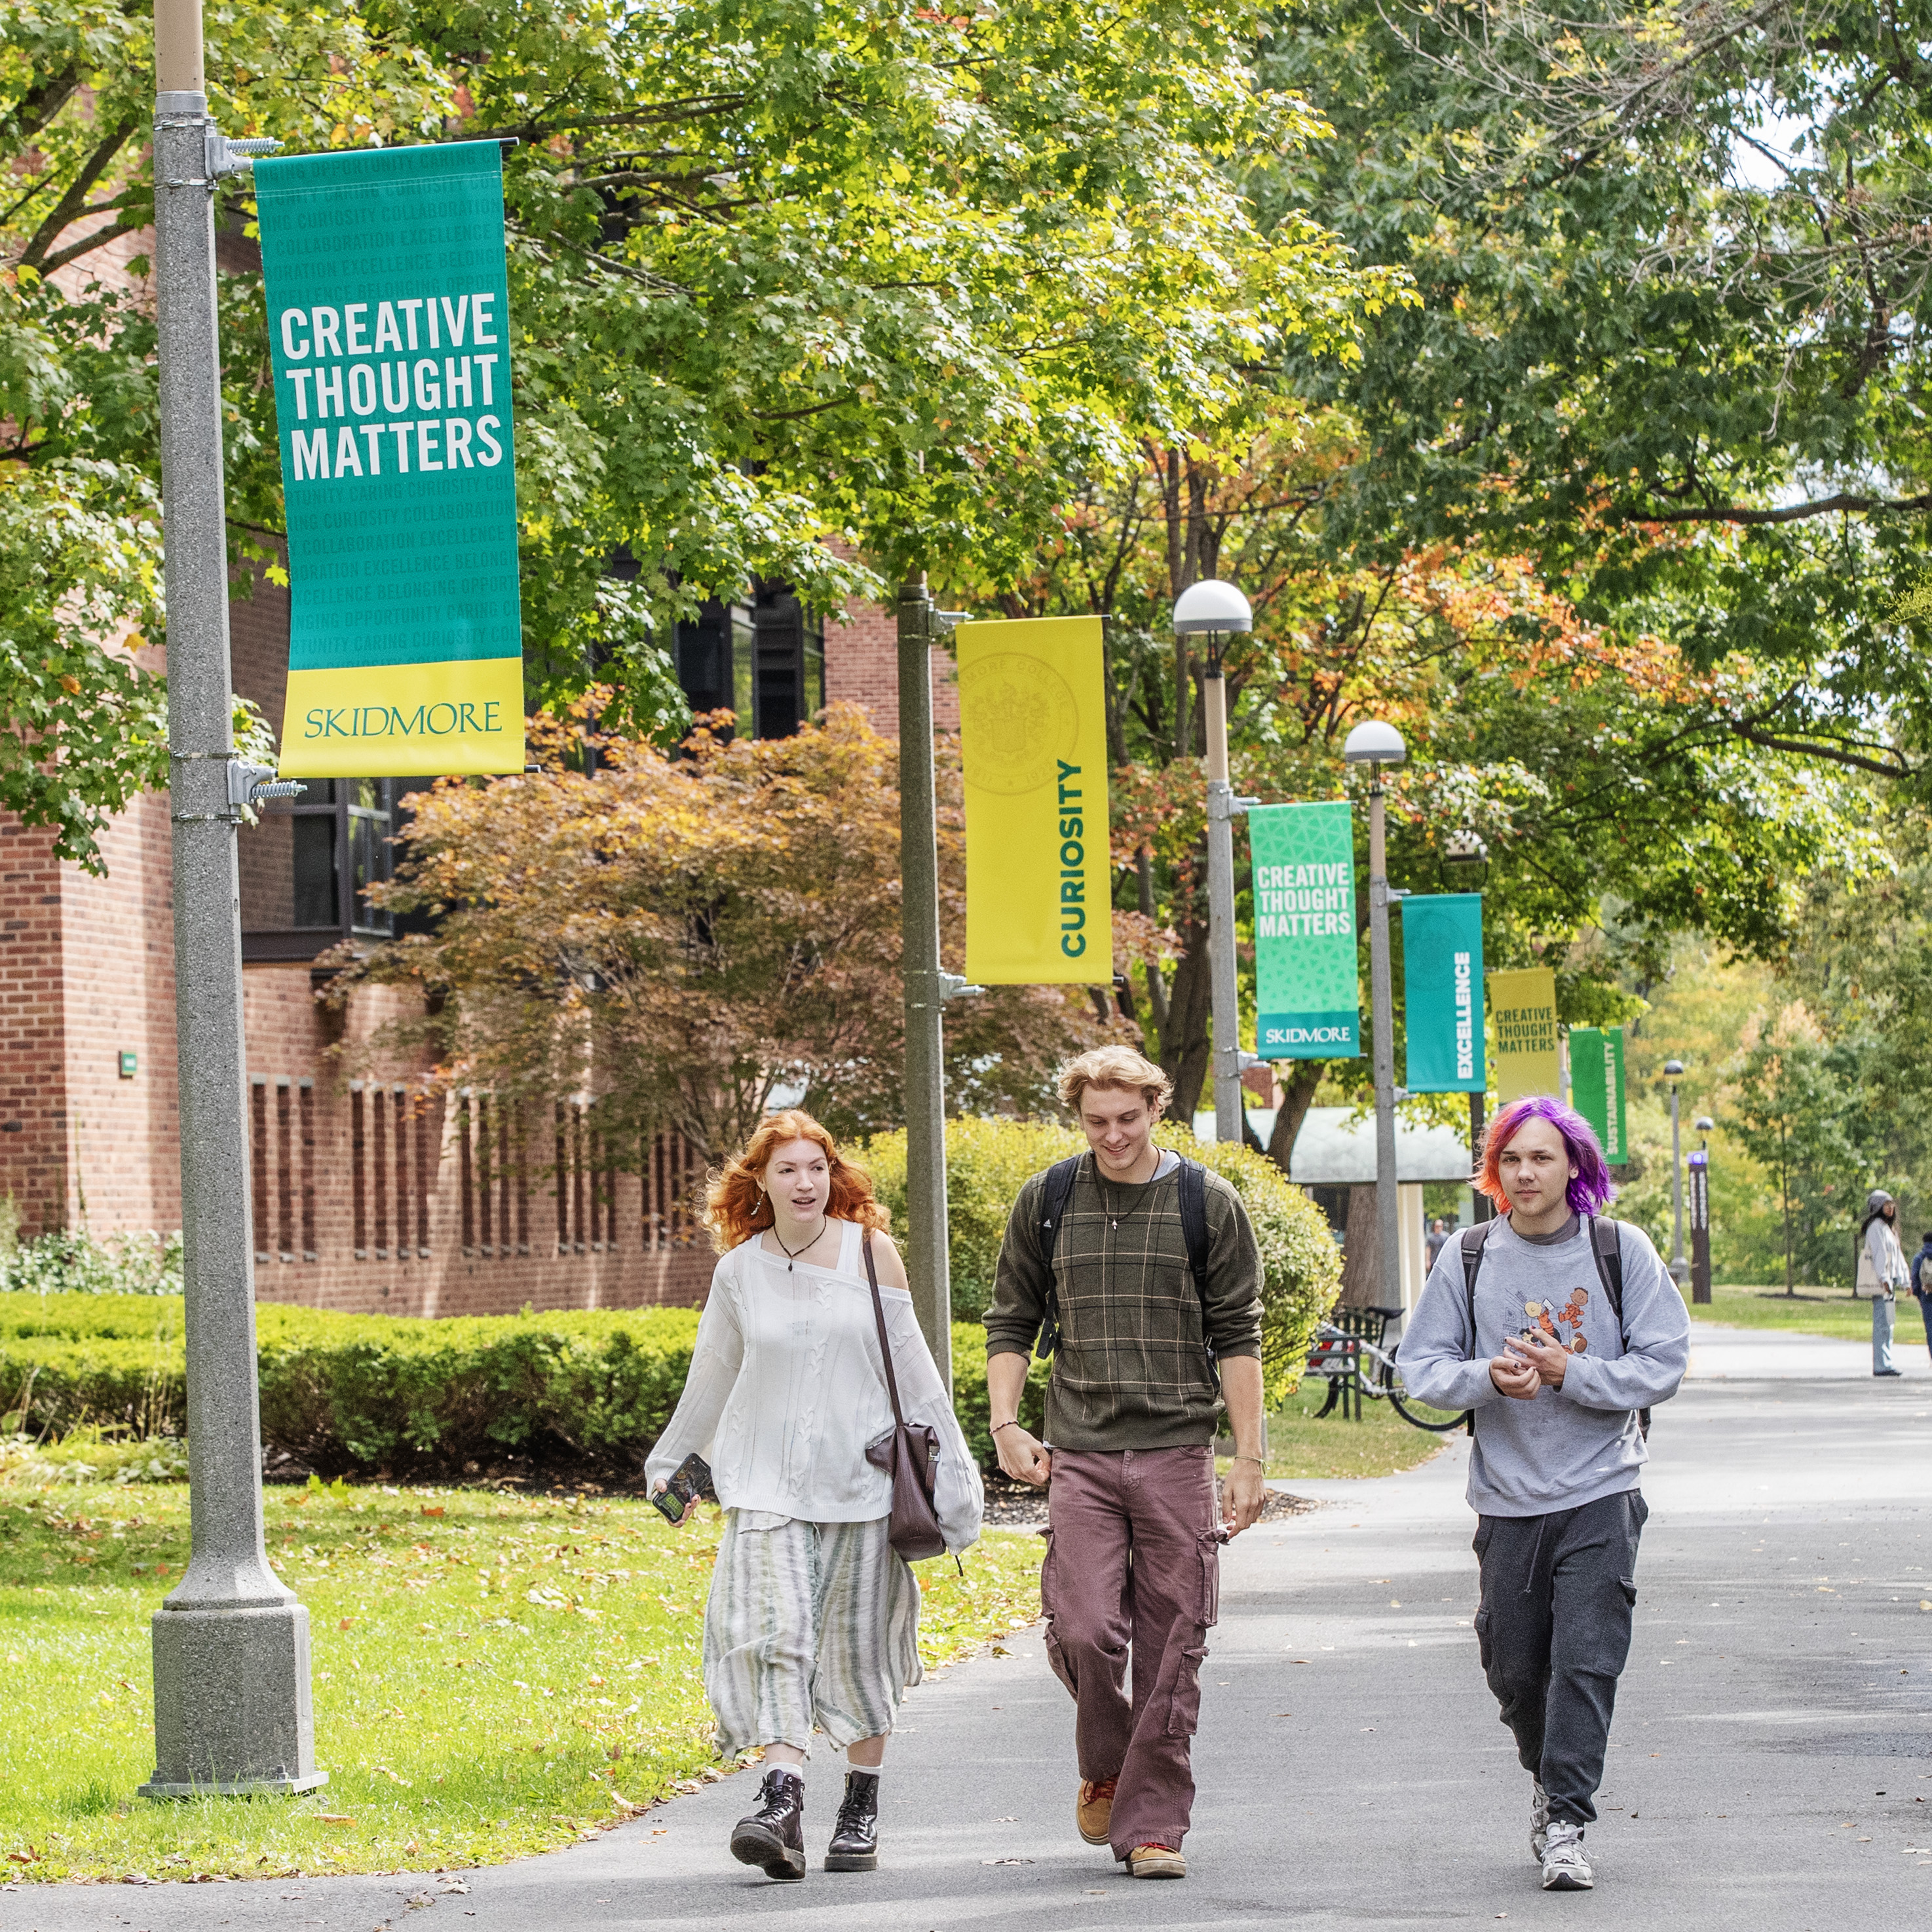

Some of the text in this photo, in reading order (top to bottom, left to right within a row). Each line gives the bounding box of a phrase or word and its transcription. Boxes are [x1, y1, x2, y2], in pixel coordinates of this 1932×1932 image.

[280, 293, 497, 360] CREATIVE
[286, 353, 498, 420] THOUGHT
[291, 415, 502, 481] MATTERS
[304, 702, 502, 738] SKIDMORE
[1057, 759, 1086, 958] CURIOSITY
[1257, 863, 1350, 888] CREATIVE
[1260, 888, 1350, 913] THOUGHT
[1259, 913, 1351, 938] MATTERS
[1454, 952, 1473, 1080] EXCELLENCE
[1496, 1007, 1552, 1023] CREATIVE
[1265, 1027, 1351, 1043] SKIDMORE
[1498, 1023, 1553, 1038] THOUGHT
[1498, 1038, 1555, 1053] MATTERS
[1604, 1042, 1619, 1155] SUSTAINABILITY
